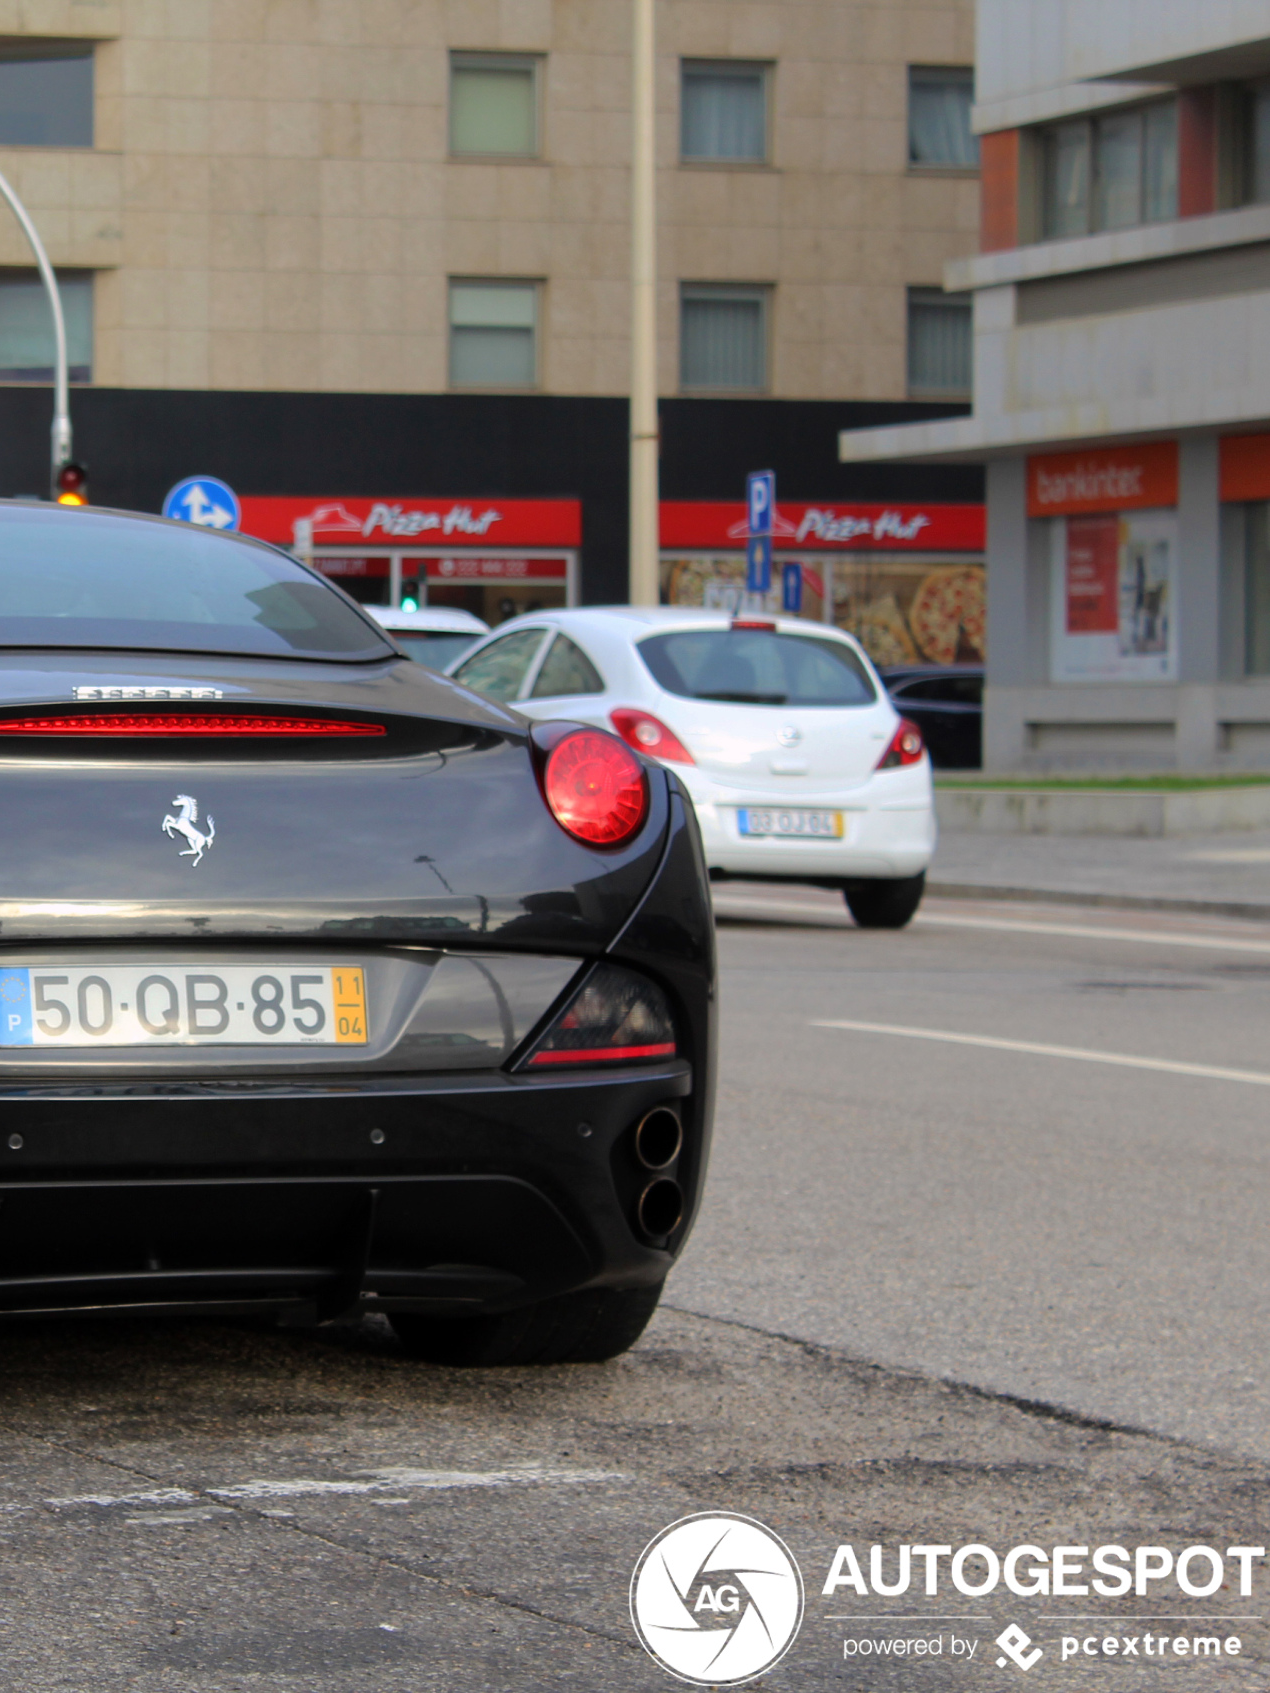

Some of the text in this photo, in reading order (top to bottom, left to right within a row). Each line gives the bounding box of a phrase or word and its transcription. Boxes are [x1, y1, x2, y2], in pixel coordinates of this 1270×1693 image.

[1037, 463, 1143, 503] bankinter
[363, 503, 503, 537] Pizza Hut
[753, 481, 767, 530] P
[796, 509, 932, 543] Pizza Hut
[9, 1015, 21, 1031] P
[339, 1017, 362, 1036] 04
